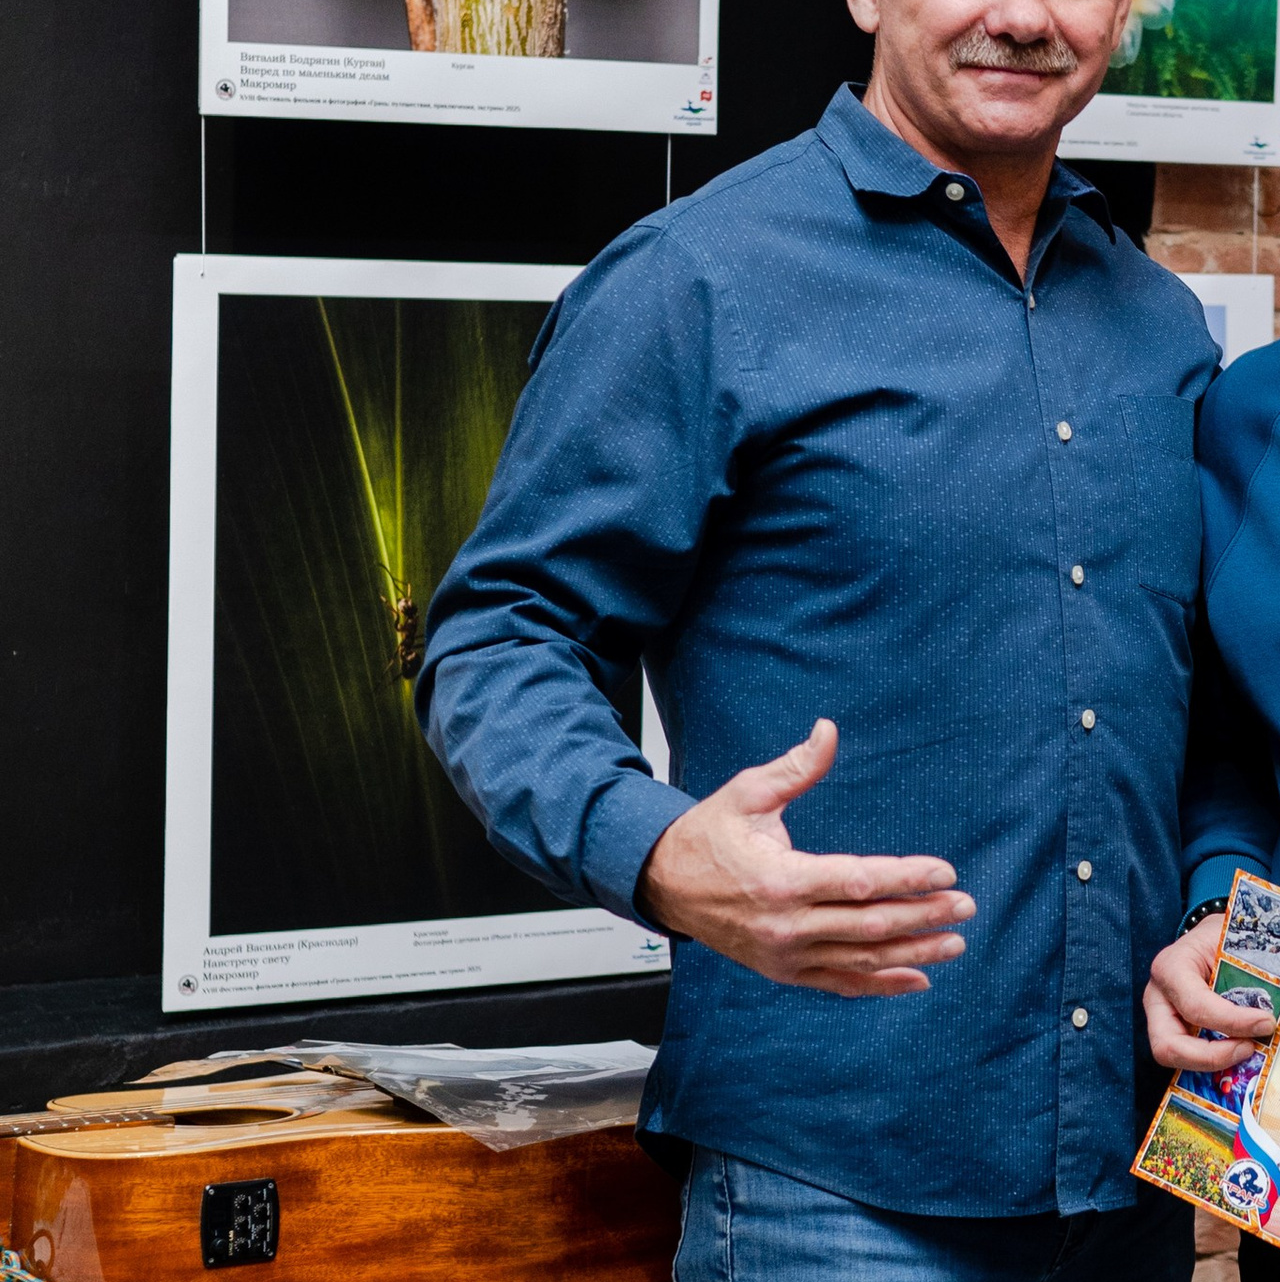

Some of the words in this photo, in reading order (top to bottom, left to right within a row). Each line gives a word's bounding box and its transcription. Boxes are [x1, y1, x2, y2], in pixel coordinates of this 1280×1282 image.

[240, 52, 287, 64] Виталий
[289, 54, 341, 68] Бодрягин
[343, 57, 386, 70] (Курган)
[240, 65, 280, 78] Вперед
[282, 69, 296, 78] по
[298, 70, 356, 80] маленьким
[358, 72, 390, 81] делам
[240, 79, 297, 91] Макромир
[203, 944, 243, 957] Андрей
[246, 942, 295, 954] Васильев
[297, 936, 359, 952] (Краснодар)
[203, 957, 259, 969] Навстречу
[262, 955, 292, 965] свету
[203, 969, 260, 982] Макромир
